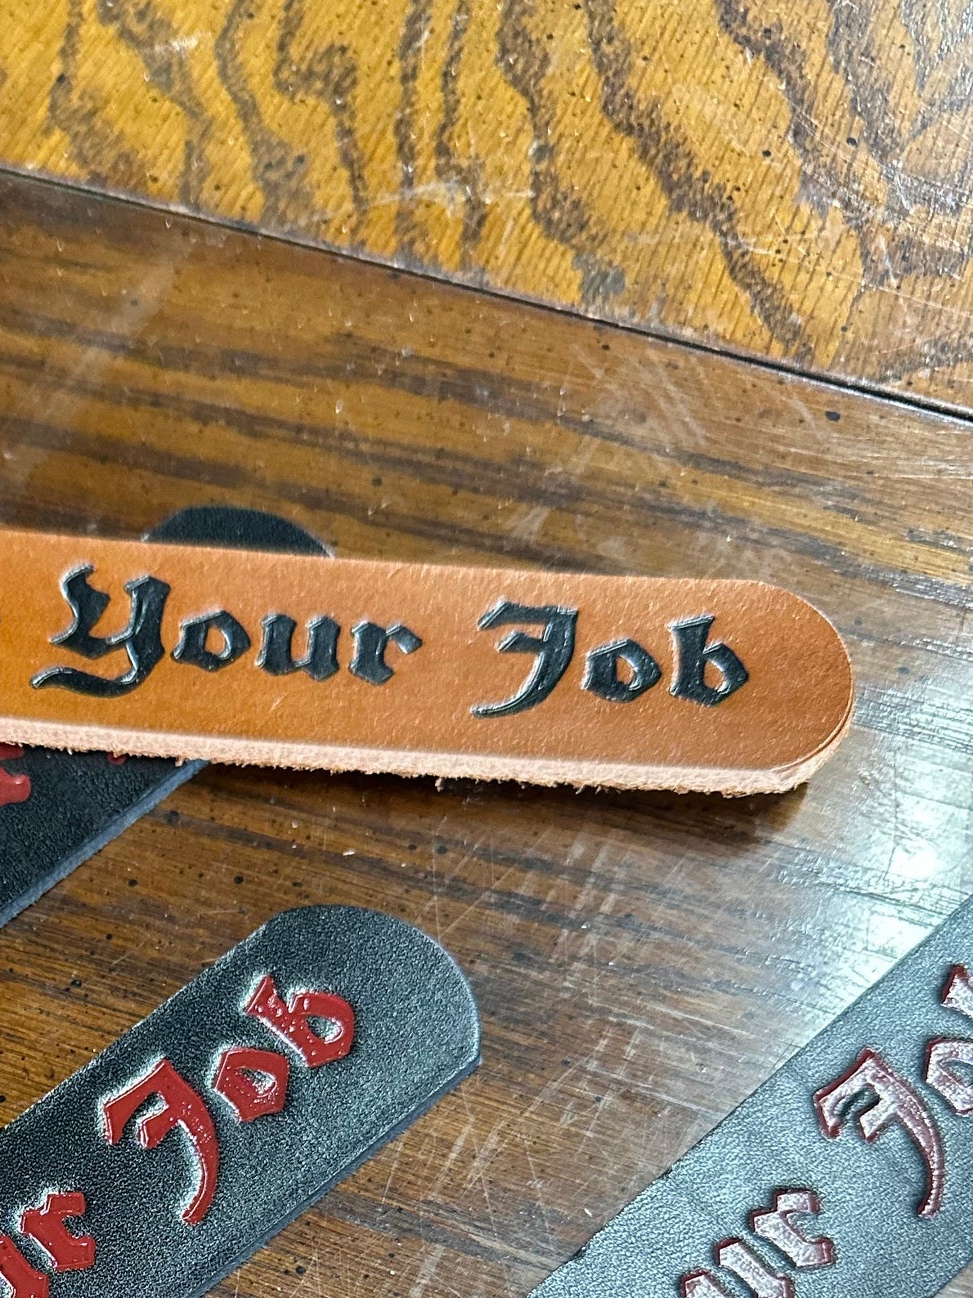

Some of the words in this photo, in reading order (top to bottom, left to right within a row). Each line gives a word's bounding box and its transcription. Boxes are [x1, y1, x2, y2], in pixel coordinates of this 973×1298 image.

[30, 564, 423, 698] Your
[470, 598, 753, 721] Job
[97, 975, 357, 1226] Job
[813, 962, 973, 1218] Jo
